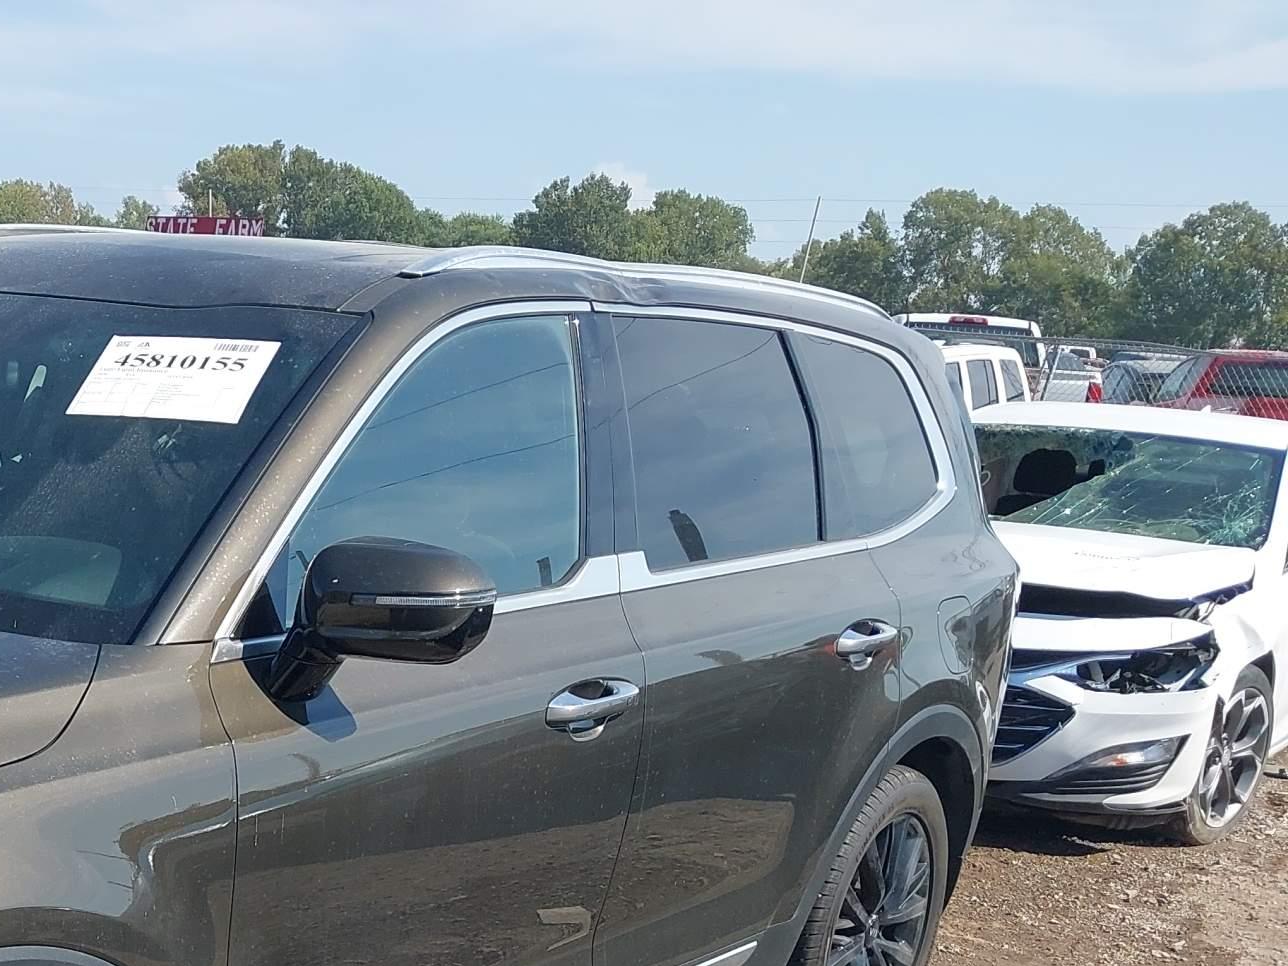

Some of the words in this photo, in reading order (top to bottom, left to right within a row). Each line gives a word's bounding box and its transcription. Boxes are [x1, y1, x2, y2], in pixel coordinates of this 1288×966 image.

[146, 217, 198, 234] STATE
[215, 218, 264, 236] FARM
[113, 352, 249, 373] 45810155
